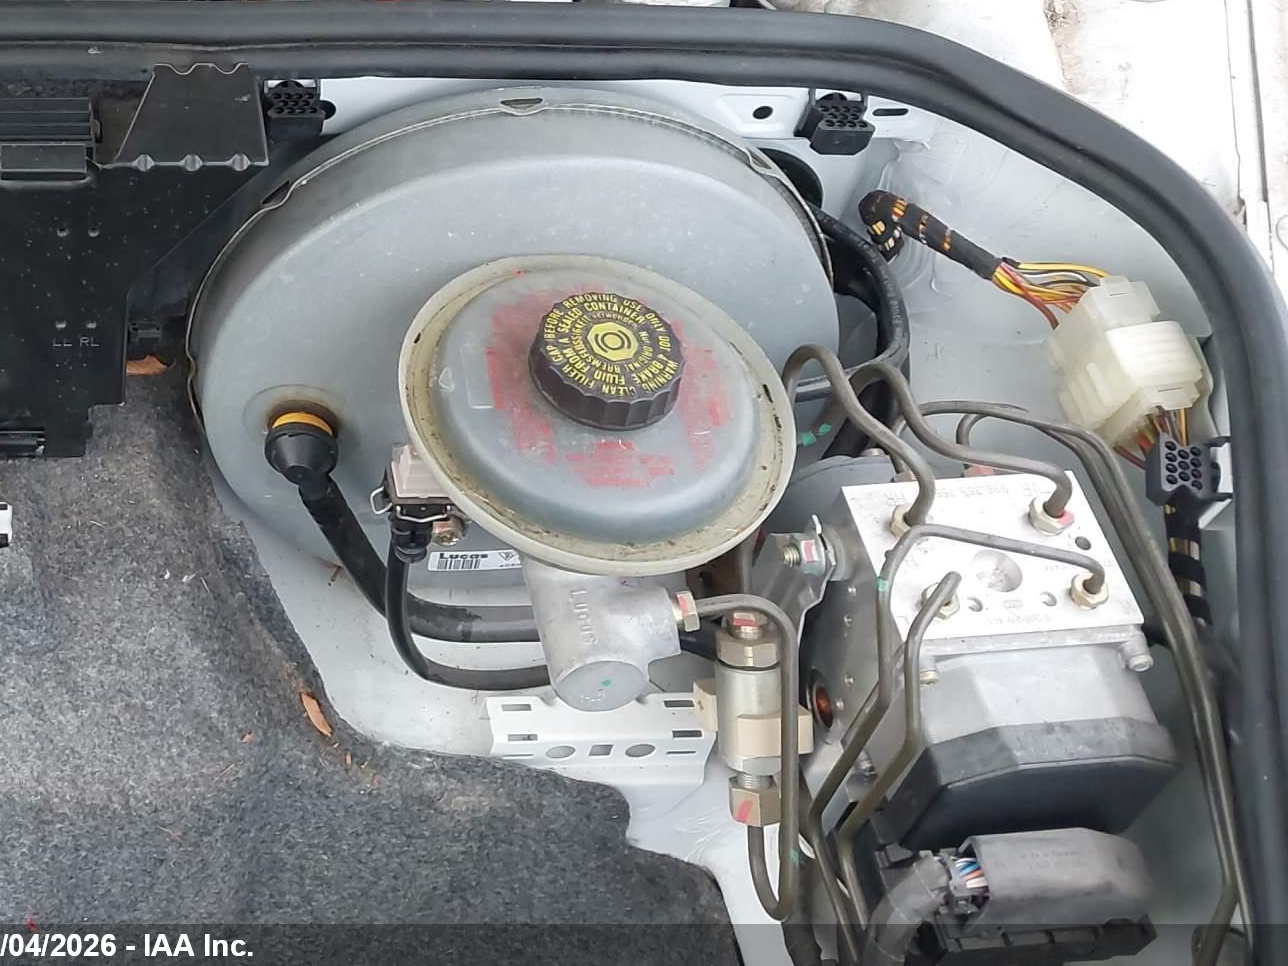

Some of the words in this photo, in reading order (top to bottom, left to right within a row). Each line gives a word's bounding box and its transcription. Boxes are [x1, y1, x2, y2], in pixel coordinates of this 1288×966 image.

[563, 294, 617, 308] REMOVING
[623, 299, 643, 312] USE
[558, 308, 582, 333] SEALED
[584, 302, 646, 323] CONTAINER
[645, 312, 666, 332] ONLY
[544, 309, 564, 339] BEFORE
[79, 336, 100, 347] RL
[658, 335, 671, 351] DOT
[546, 345, 563, 362] CAP
[562, 348, 590, 372] FROM
[626, 346, 654, 372] ORIGINAL
[562, 364, 595, 389] FILLER
[594, 370, 625, 385] FLUID
[632, 361, 663, 384] BRAKE
[642, 359, 679, 393] WARNING
[601, 385, 636, 397] CLEAN
[568, 588, 599, 647] Lucas
